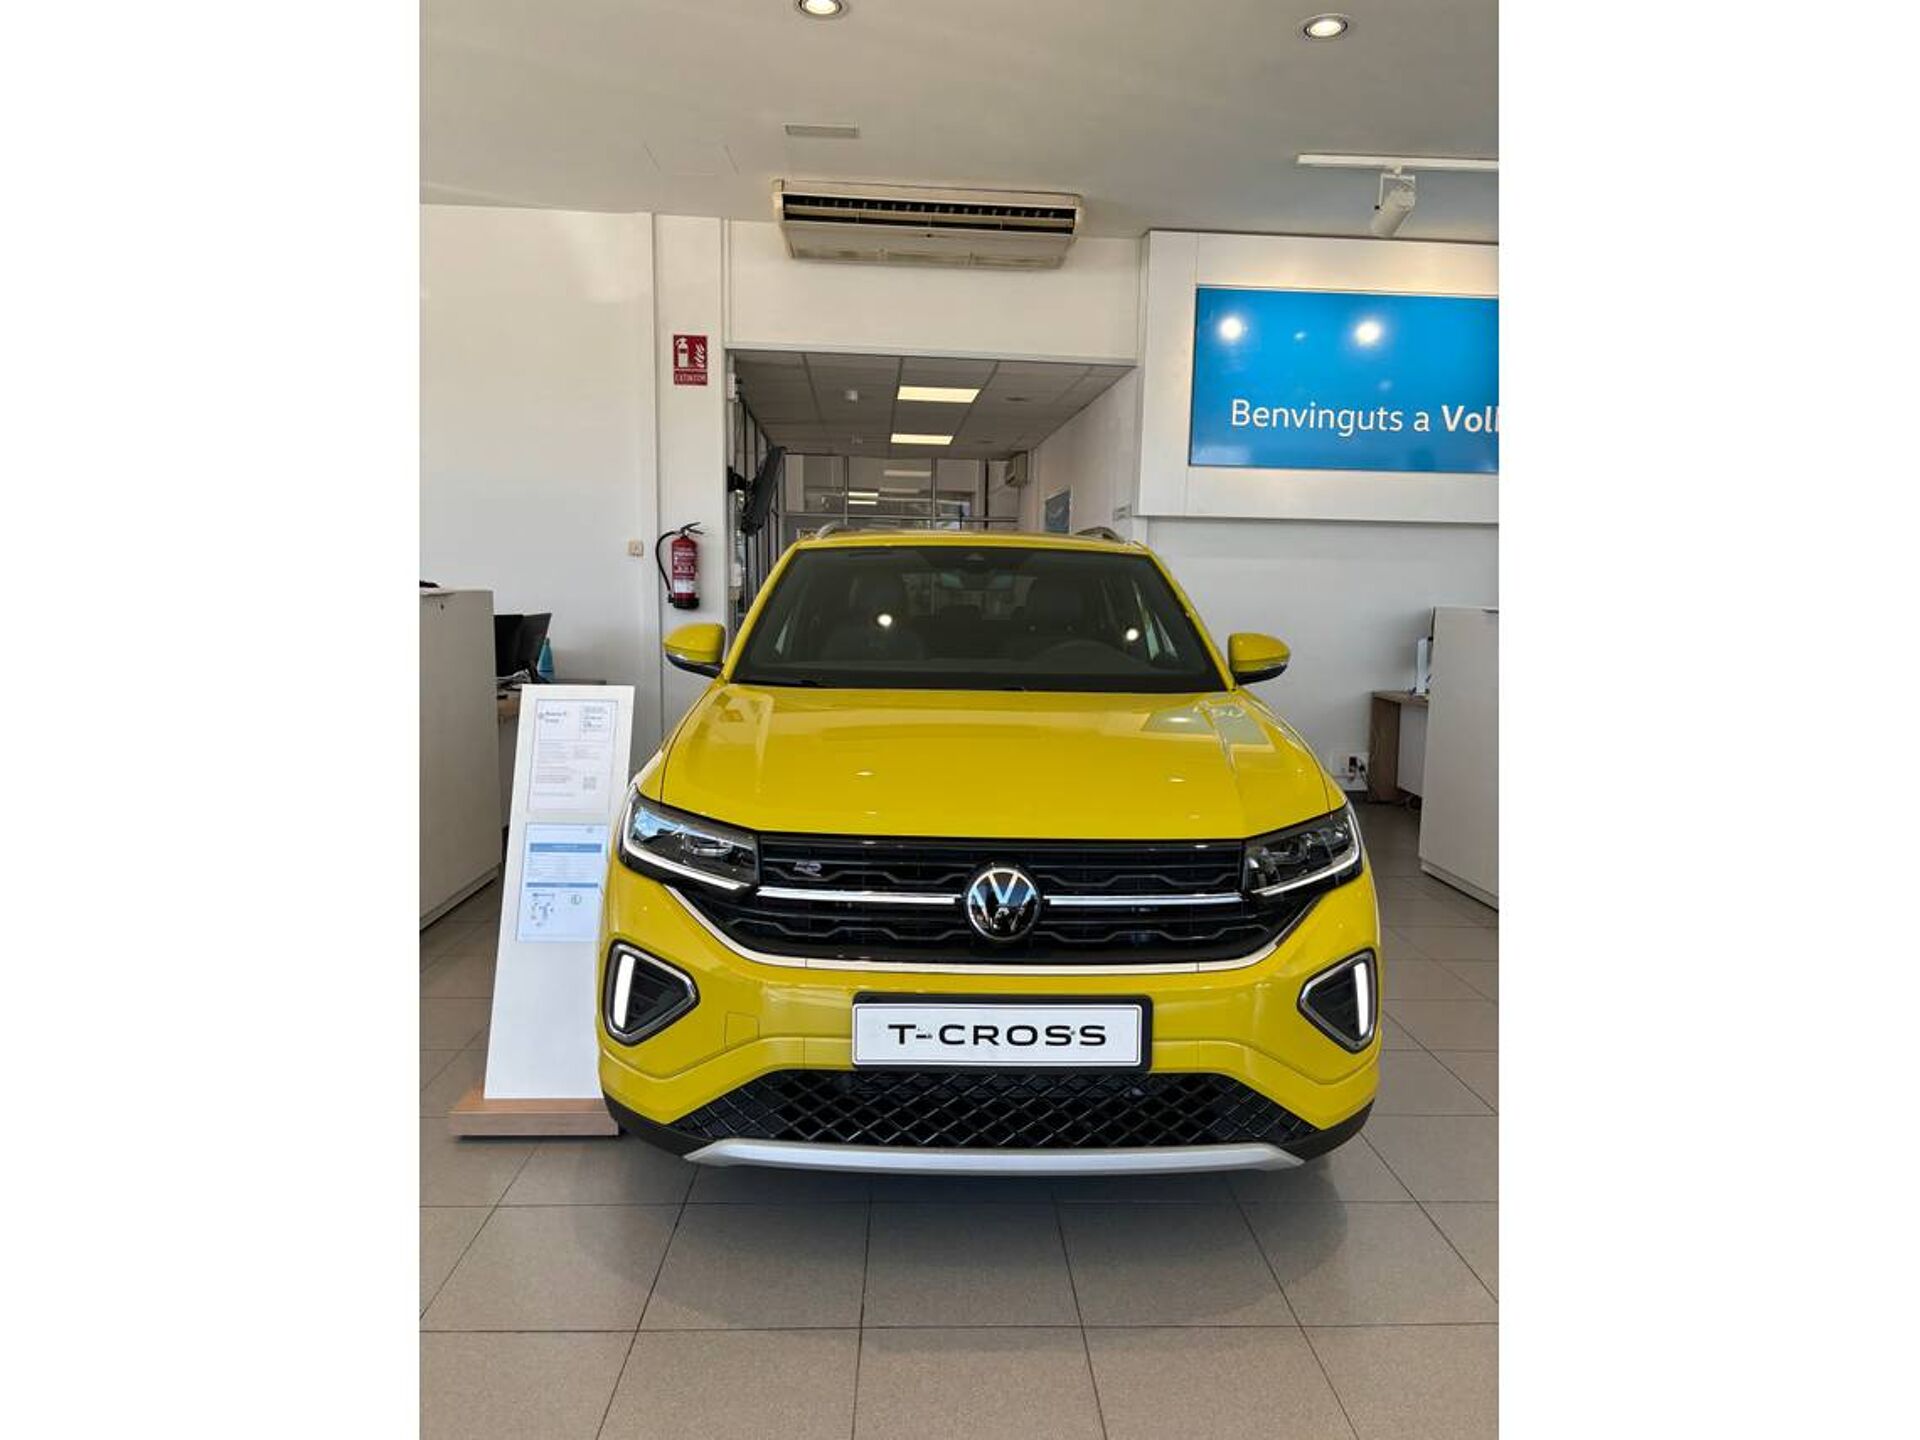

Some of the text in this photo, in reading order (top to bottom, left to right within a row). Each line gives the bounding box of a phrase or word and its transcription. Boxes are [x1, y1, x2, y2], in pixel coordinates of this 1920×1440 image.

[1231, 398, 1499, 437] Benvinguts a Vol
[887, 1024, 1107, 1046] T-CROSS
